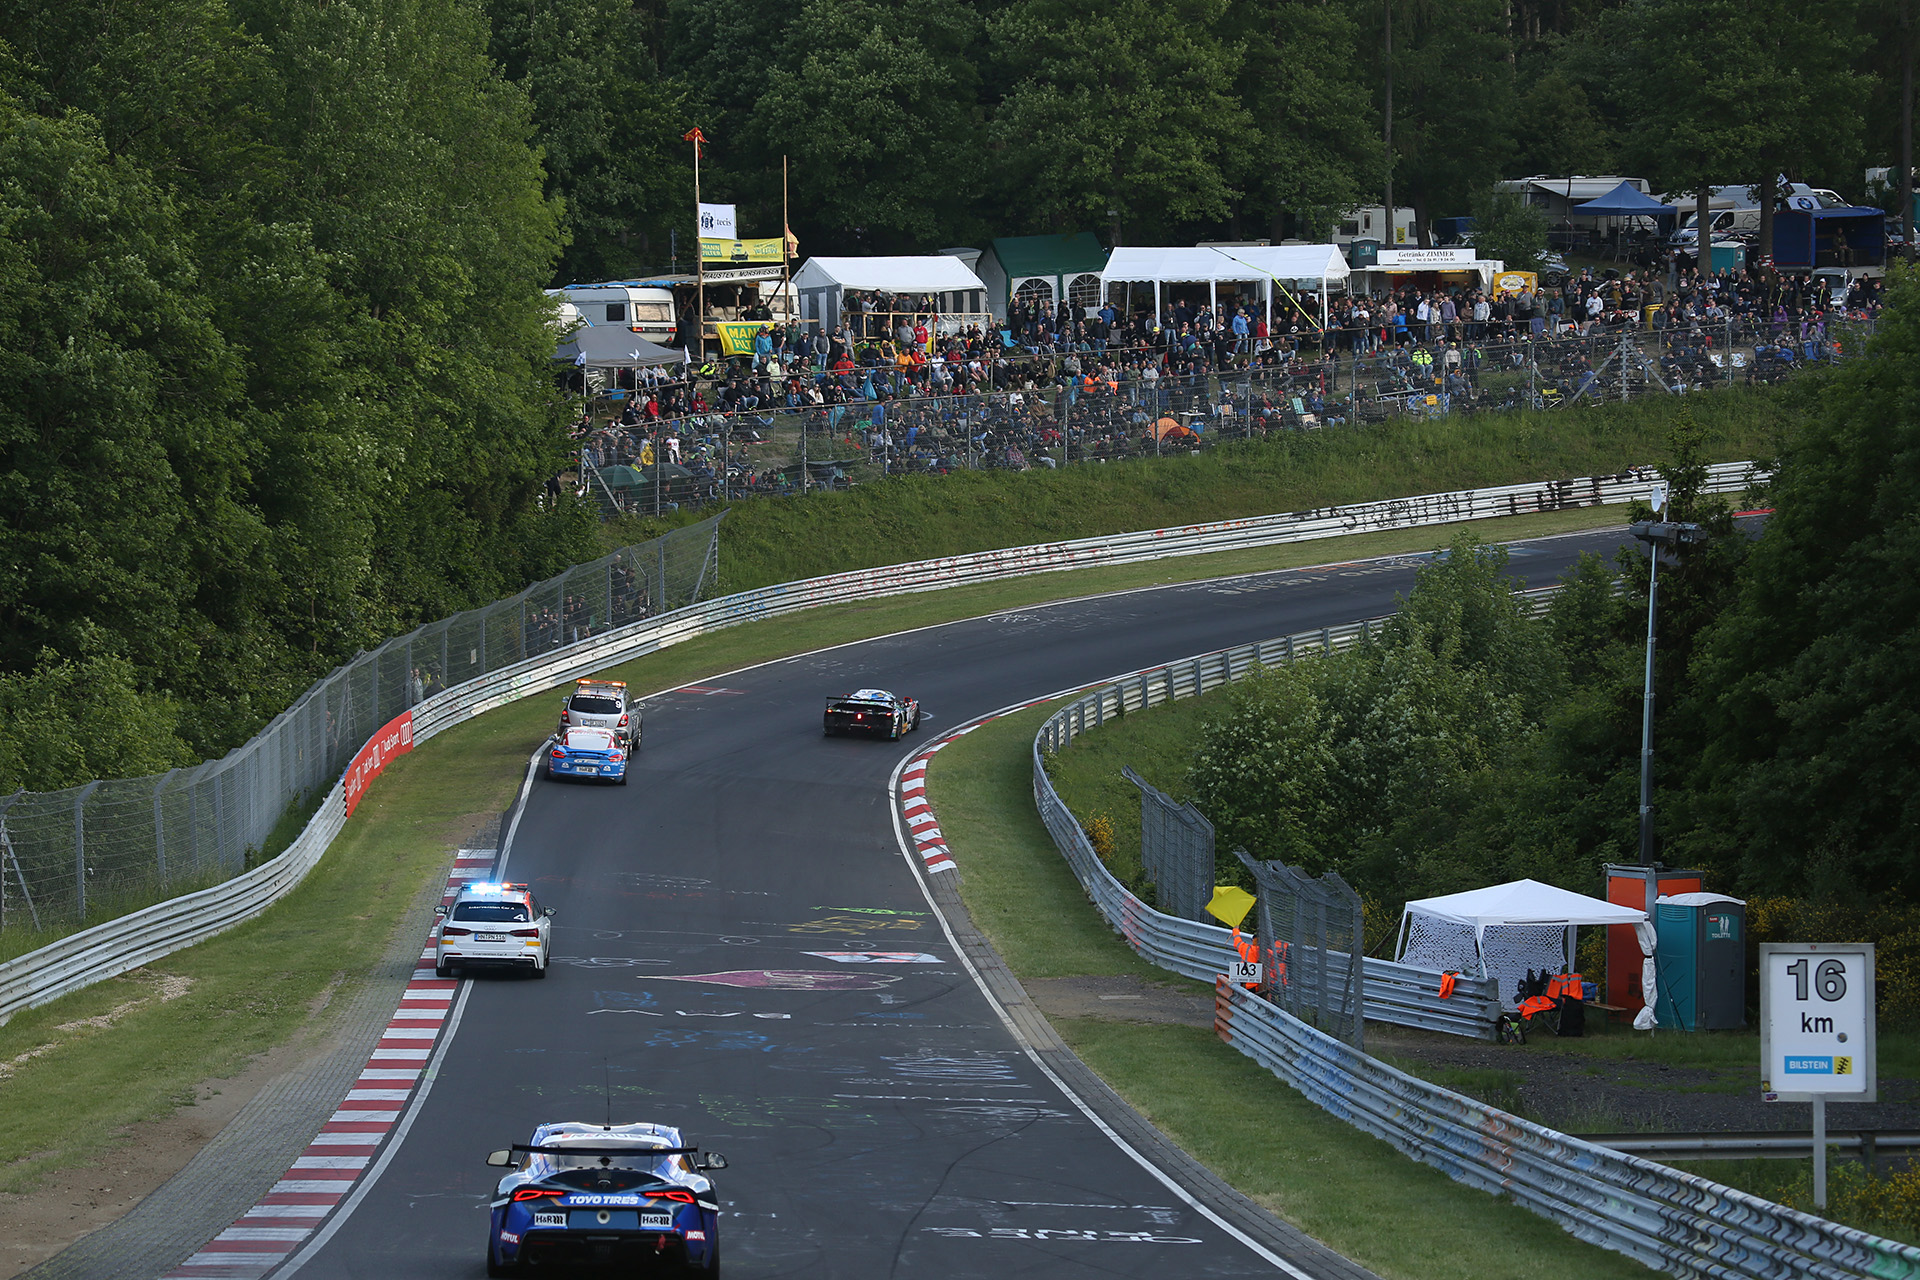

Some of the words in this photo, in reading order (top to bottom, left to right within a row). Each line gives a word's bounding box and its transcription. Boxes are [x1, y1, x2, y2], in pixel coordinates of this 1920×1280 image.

[716, 218, 732, 226] tecis
[703, 271, 735, 279] HAUSTEN
[728, 327, 759, 339] MAN
[615, 700, 622, 709] 9
[513, 914, 526, 922] 4
[1236, 963, 1257, 977] 163
[1787, 959, 1847, 1002] 16
[1801, 1012, 1834, 1033] km
[1789, 1060, 1829, 1070] BILSTEIN
[569, 1196, 602, 1204] TOYO
[604, 1196, 639, 1205] TIRES
[501, 1231, 519, 1244] MOTUL
[686, 1231, 705, 1240] MOTUL
